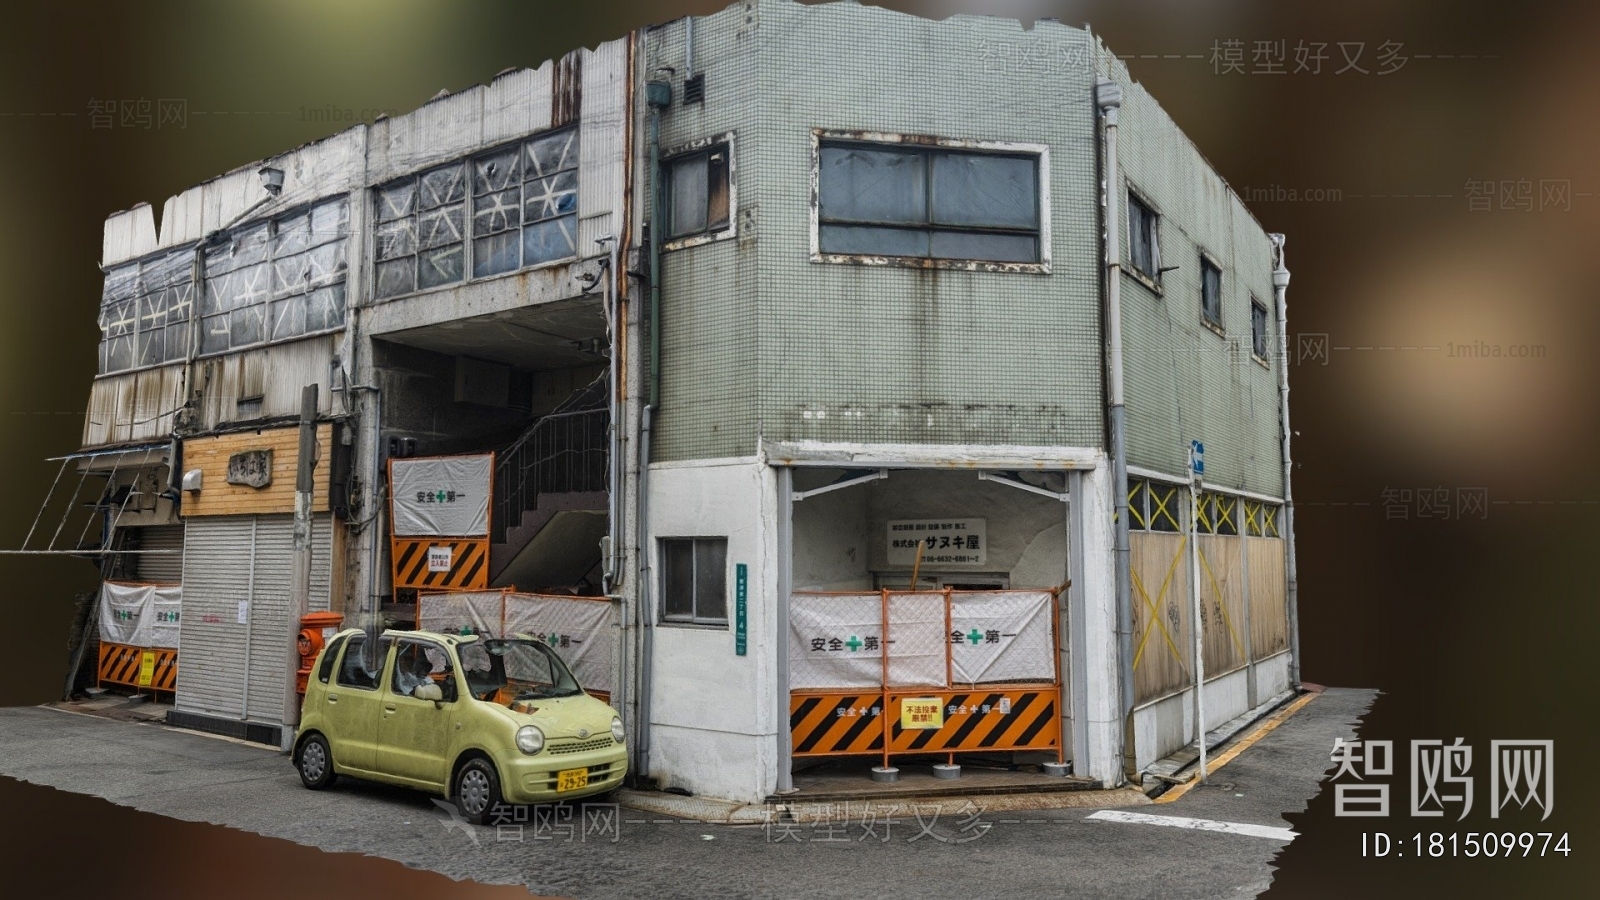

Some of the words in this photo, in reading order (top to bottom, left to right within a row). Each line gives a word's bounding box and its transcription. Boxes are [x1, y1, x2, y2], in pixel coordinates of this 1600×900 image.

[416, 491, 435, 503] 安全
[446, 490, 466, 503] 第一
[925, 534, 980, 550] サヌキ屋
[560, 634, 582, 648] 第一
[985, 629, 1017, 644] 第一
[811, 637, 844, 652] 安全
[836, 707, 857, 717] 安全
[906, 705, 938, 714] 不法投棄
[948, 705, 968, 714] 安全
[564, 775, 587, 790] 29-25
